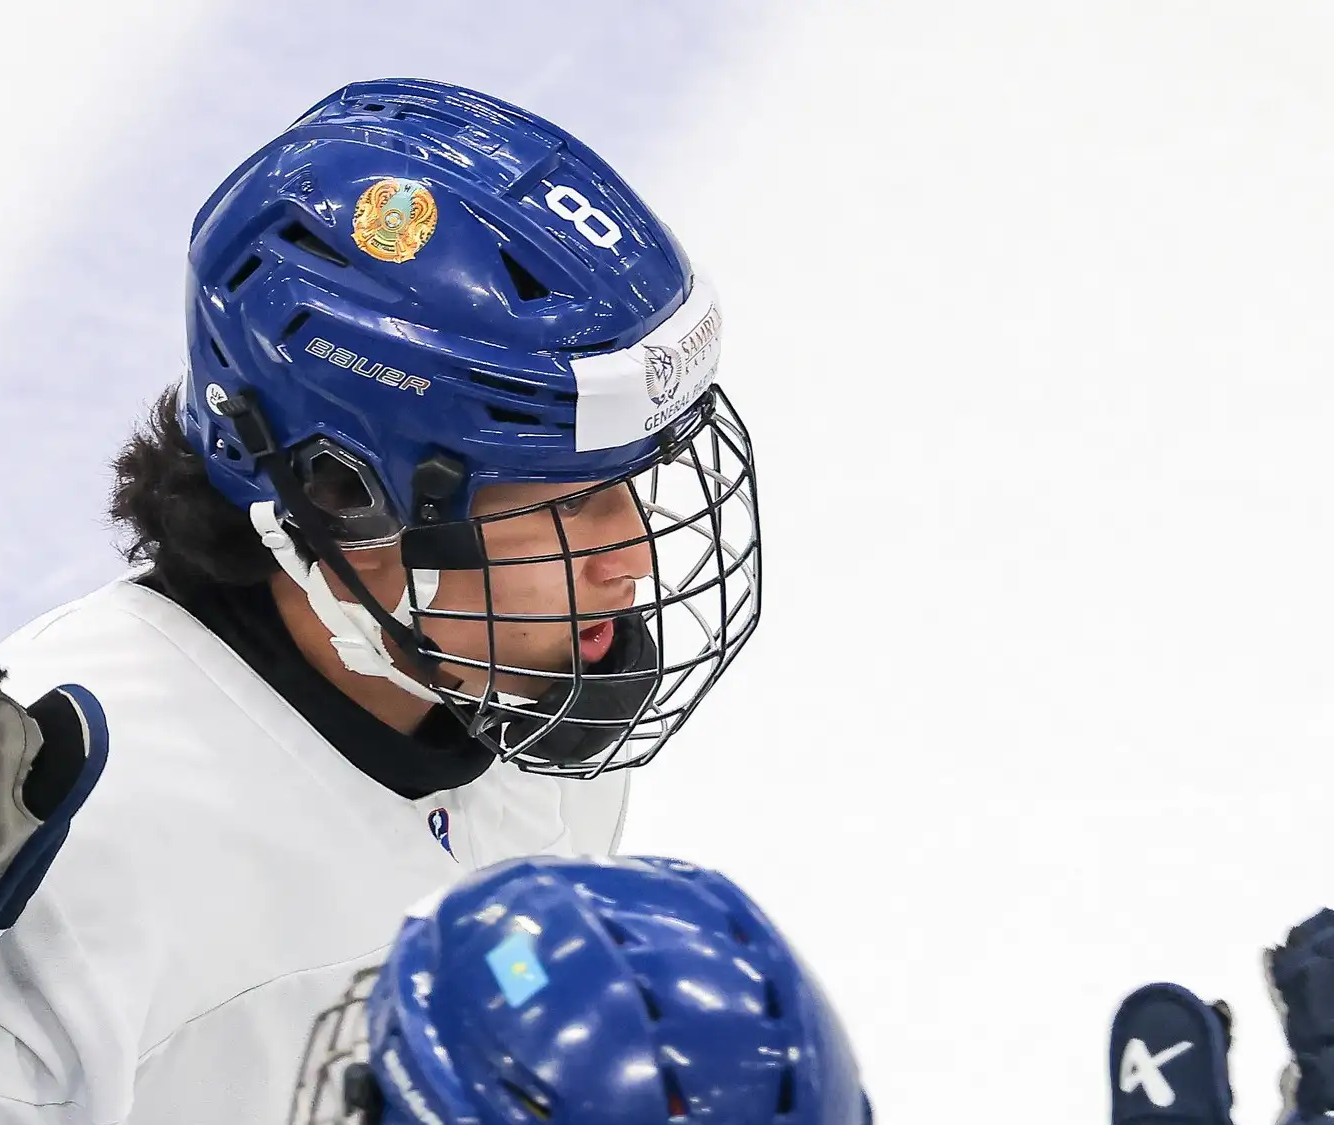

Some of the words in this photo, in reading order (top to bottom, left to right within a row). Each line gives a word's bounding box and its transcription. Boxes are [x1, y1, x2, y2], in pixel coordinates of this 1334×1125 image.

[544, 184, 623, 249] 8
[304, 337, 431, 396] BAUER
[644, 391, 690, 432] GENERAL
